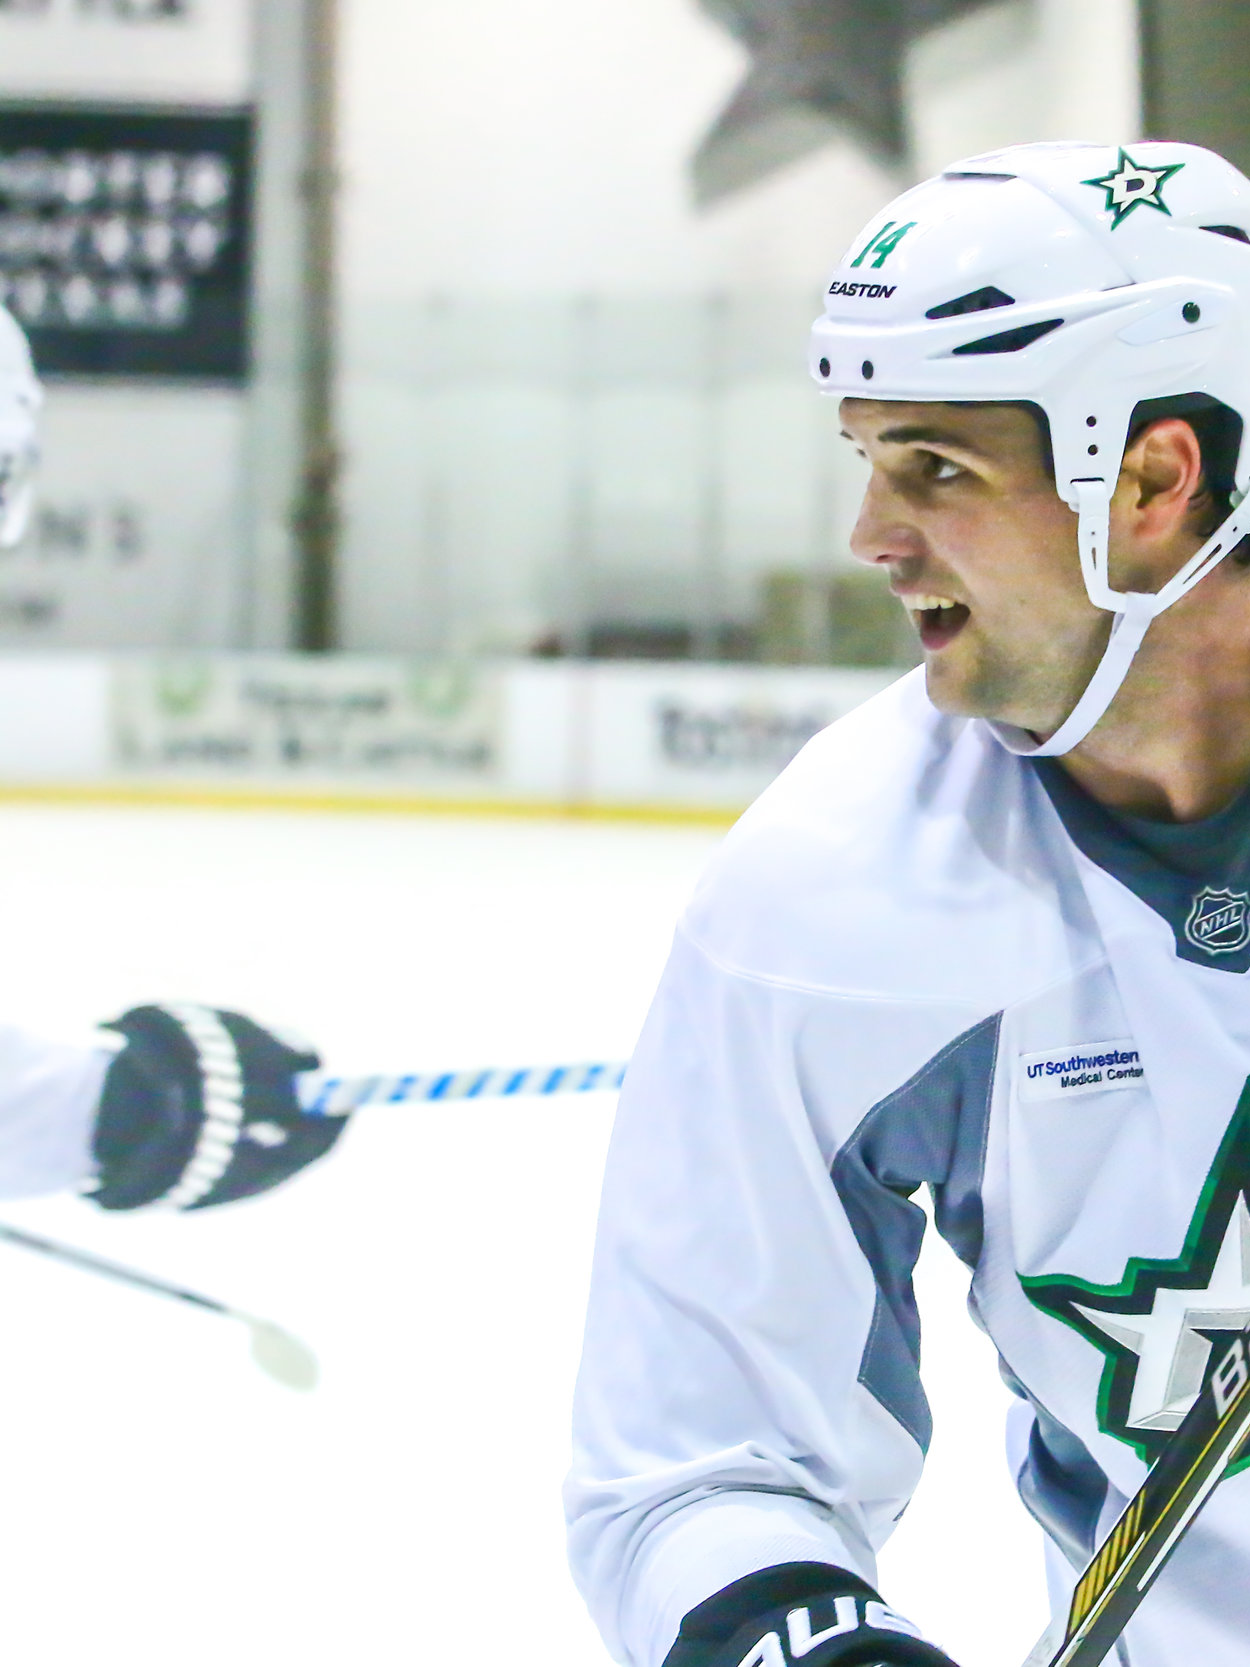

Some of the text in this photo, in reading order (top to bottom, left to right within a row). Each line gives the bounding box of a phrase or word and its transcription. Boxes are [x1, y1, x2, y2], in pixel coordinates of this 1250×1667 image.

[850, 221, 918, 268] 14
[828, 282, 897, 298] EASTON
[1200, 908, 1241, 936] NHL
[1027, 1063, 1045, 1078] UT
[1061, 1072, 1102, 1088] Medical
